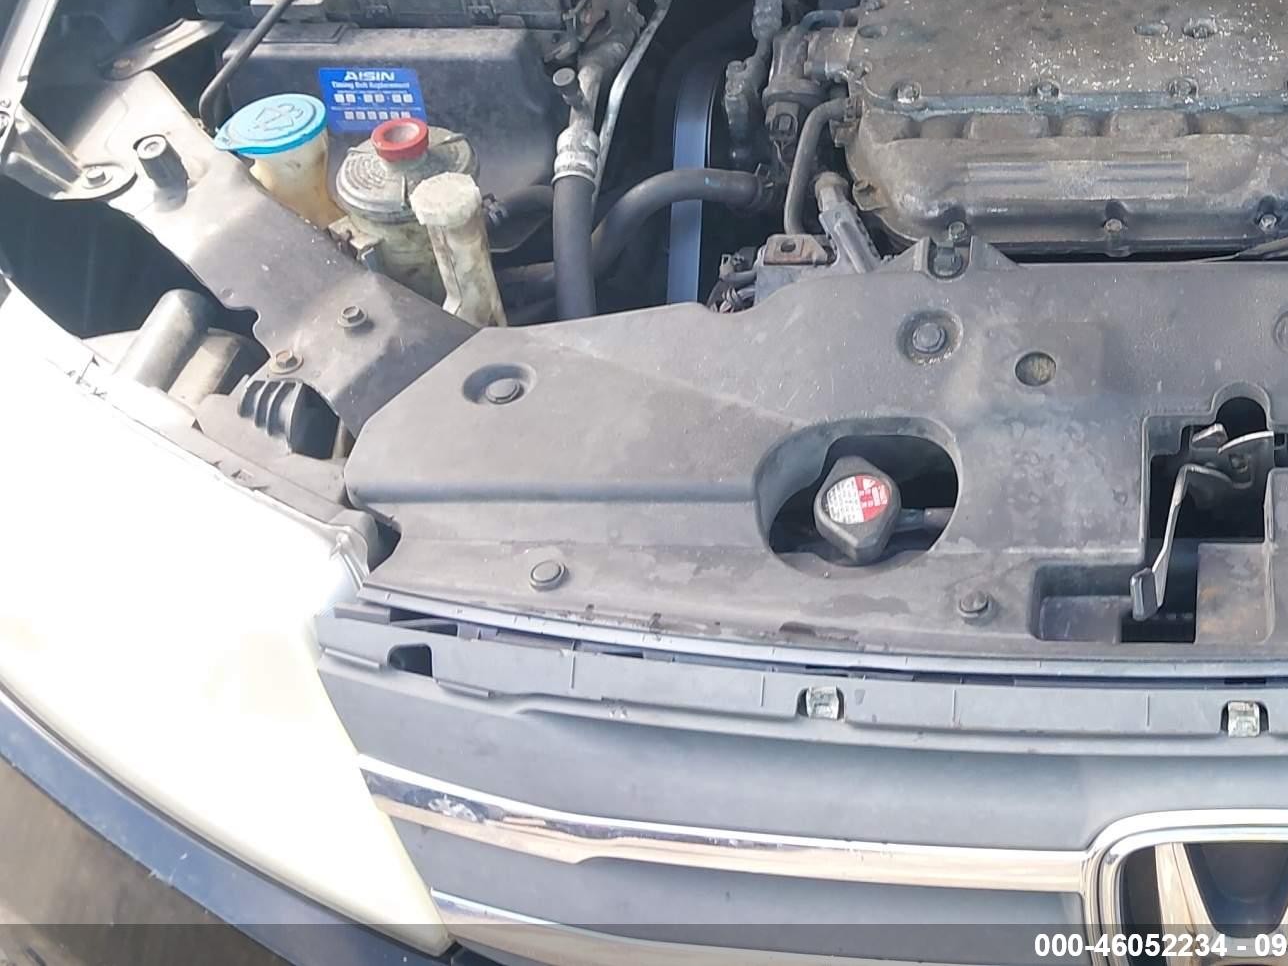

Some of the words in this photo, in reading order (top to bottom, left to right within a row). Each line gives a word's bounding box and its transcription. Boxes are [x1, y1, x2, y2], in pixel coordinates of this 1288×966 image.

[344, 70, 395, 81] AISIN
[331, 81, 354, 89] Timing
[355, 81, 368, 89] Belt
